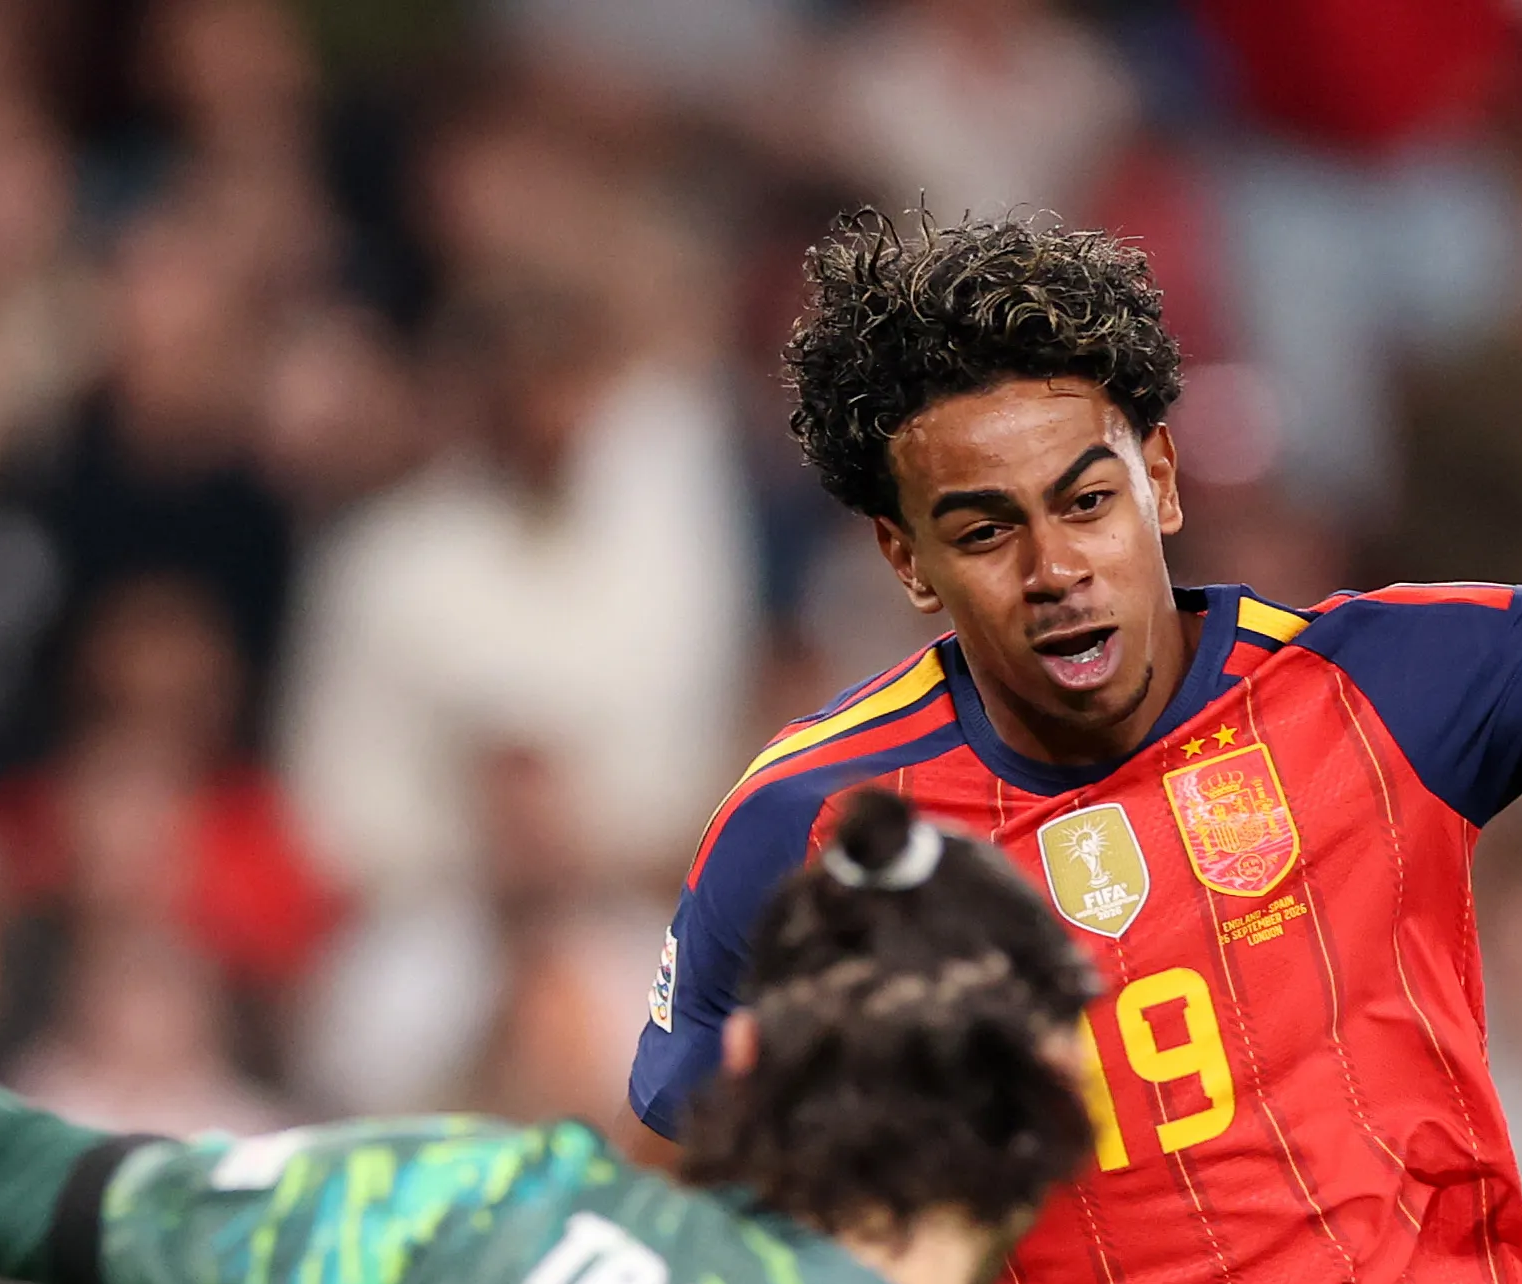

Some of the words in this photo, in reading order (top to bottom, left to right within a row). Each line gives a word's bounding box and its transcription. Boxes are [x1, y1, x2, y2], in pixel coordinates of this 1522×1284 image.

[1083, 884, 1128, 911] FIFA
[1222, 910, 1261, 932] ENGLAND
[1268, 895, 1295, 913] SPAIN
[1231, 912, 1283, 940] SEPTEMBER
[1283, 903, 1307, 920] 2026
[1247, 924, 1284, 946] LONDON
